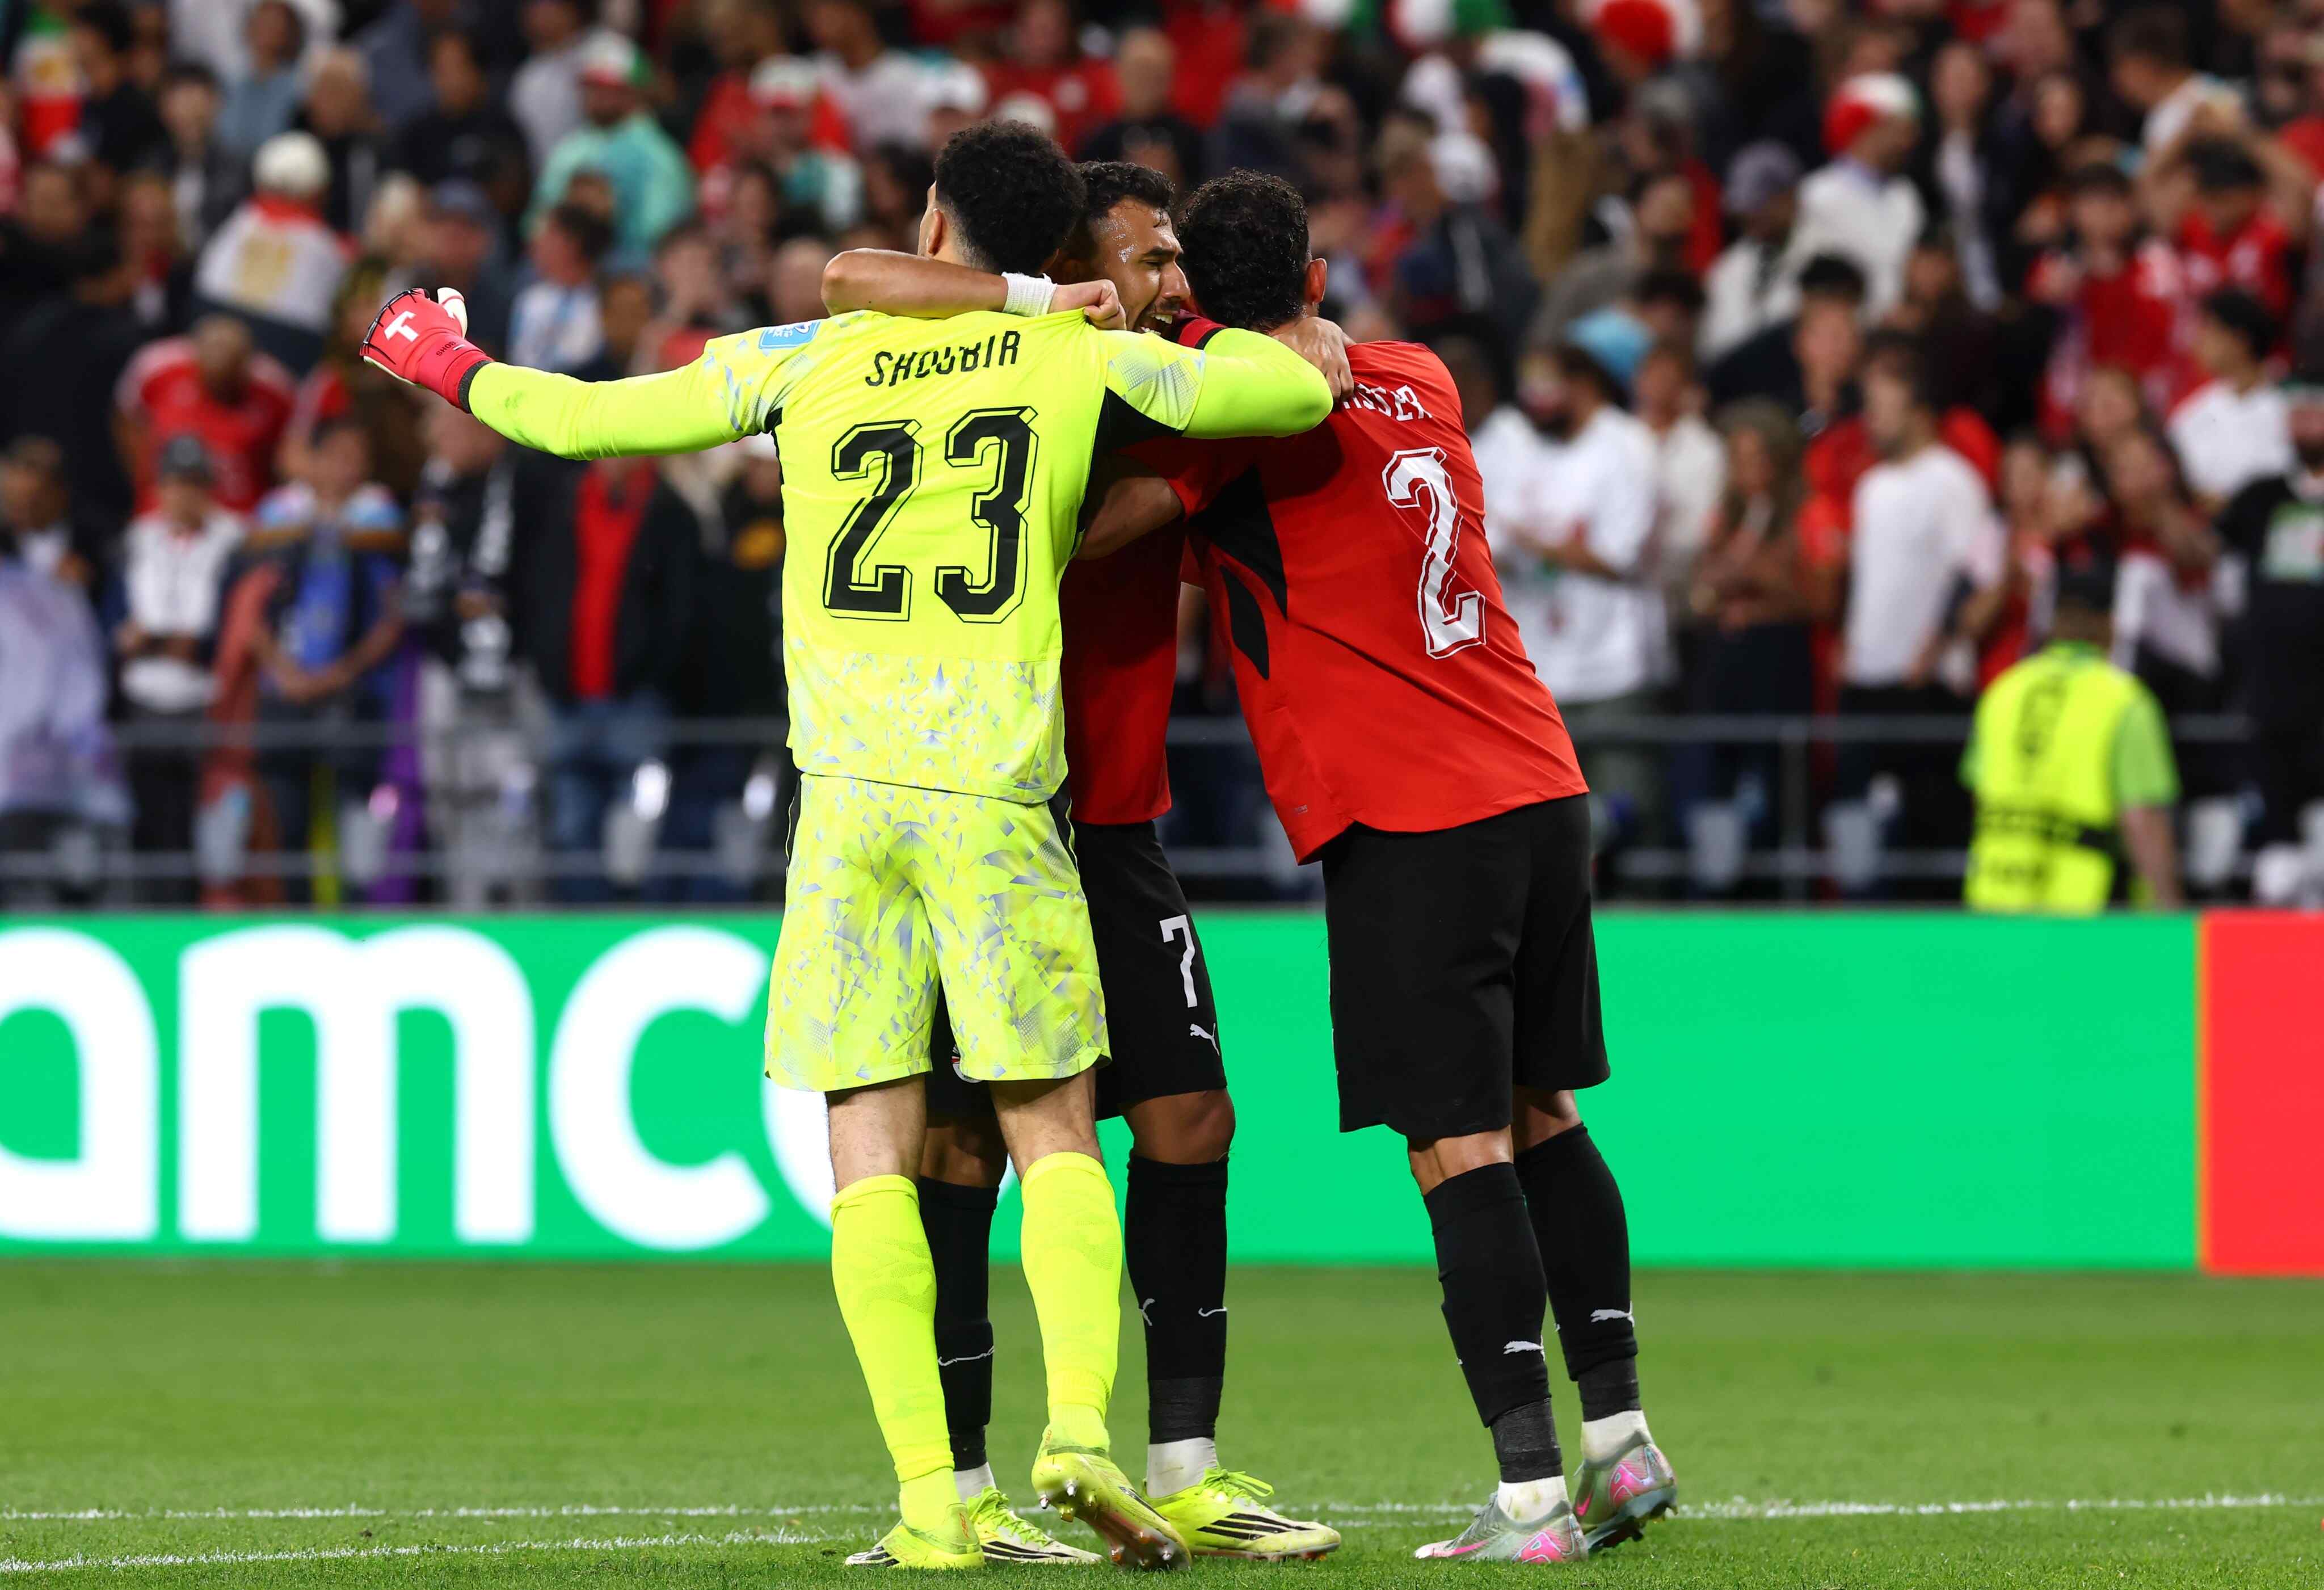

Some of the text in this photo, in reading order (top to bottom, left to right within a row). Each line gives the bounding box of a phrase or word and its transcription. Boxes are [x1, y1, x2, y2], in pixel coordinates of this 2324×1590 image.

[865, 330, 1021, 386] SHOUBIR
[823, 405, 1039, 624] 23
[1381, 446, 1487, 659] 2
[1159, 914, 1198, 1008] 7
